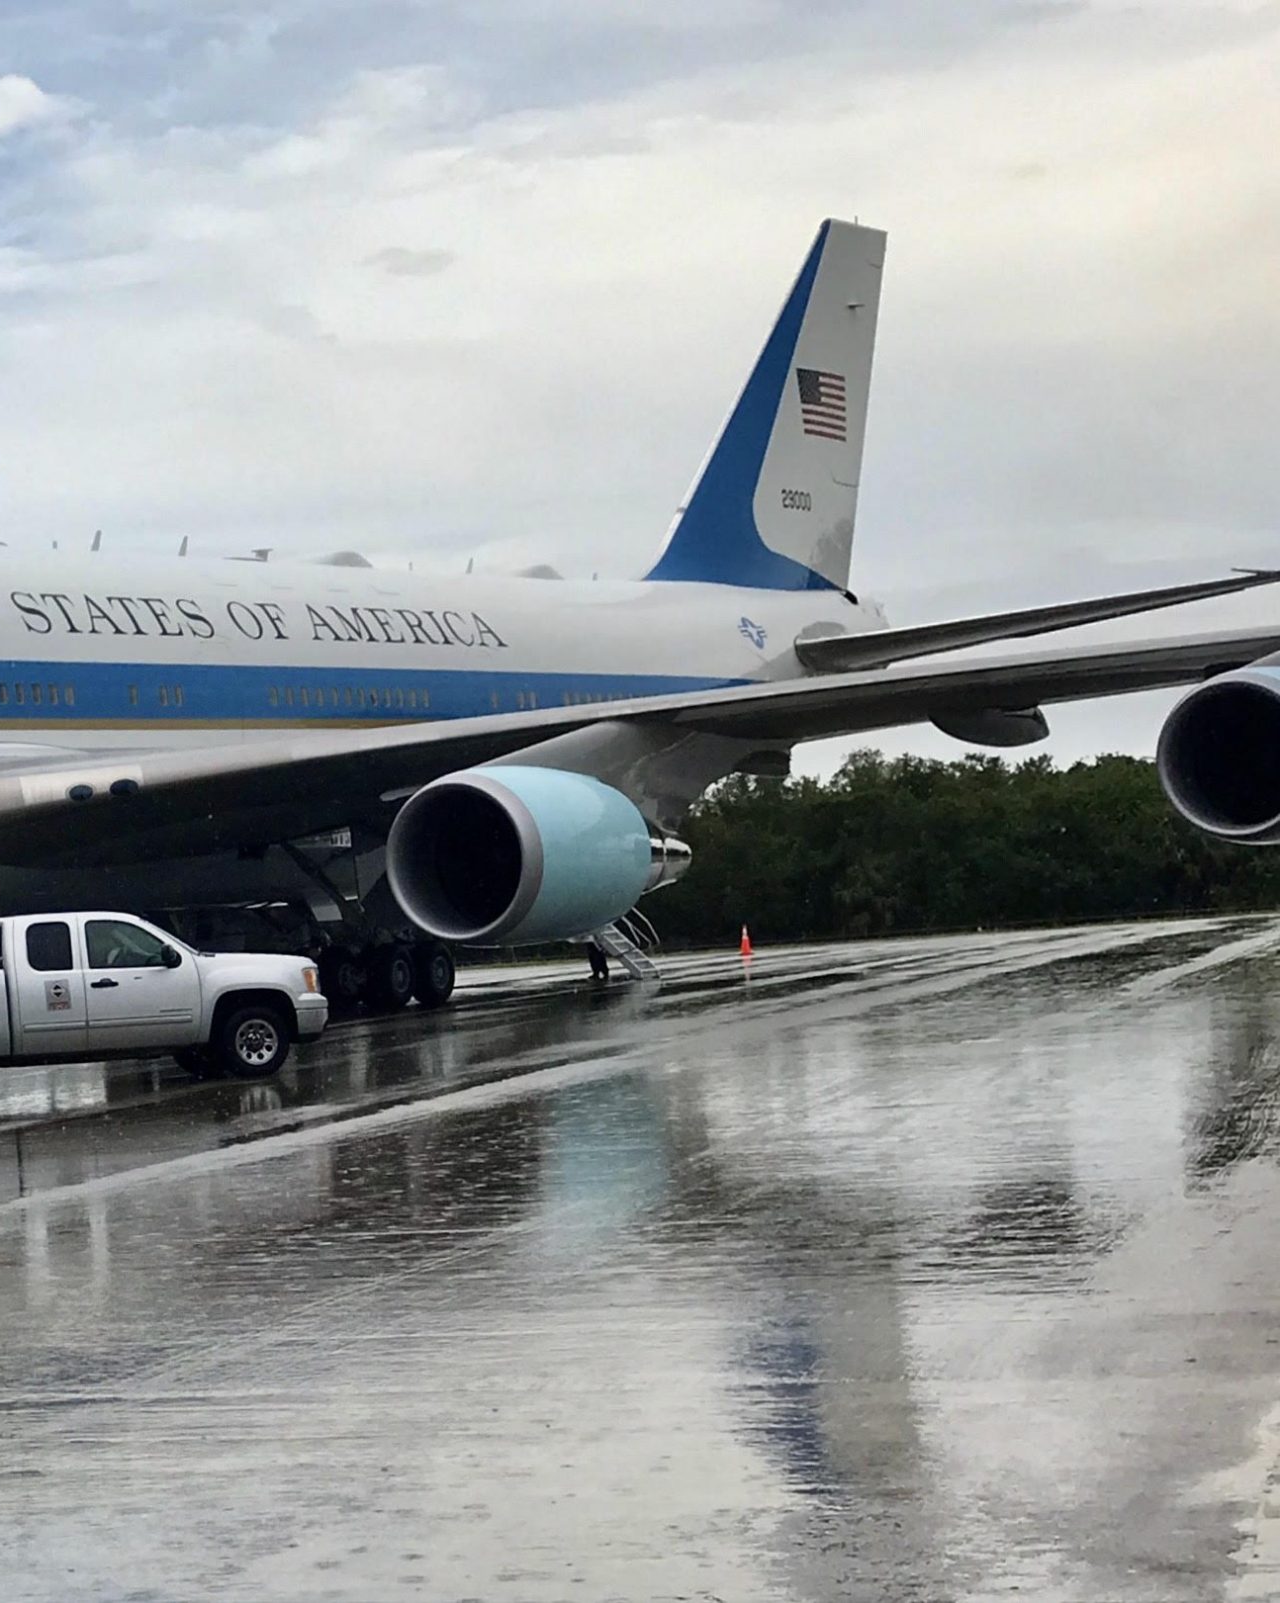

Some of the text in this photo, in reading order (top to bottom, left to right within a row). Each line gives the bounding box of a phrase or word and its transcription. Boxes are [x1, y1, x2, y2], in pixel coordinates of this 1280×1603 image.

[10, 591, 215, 639] STATES
[226, 601, 290, 640] OF
[305, 603, 509, 648] AMERICA
